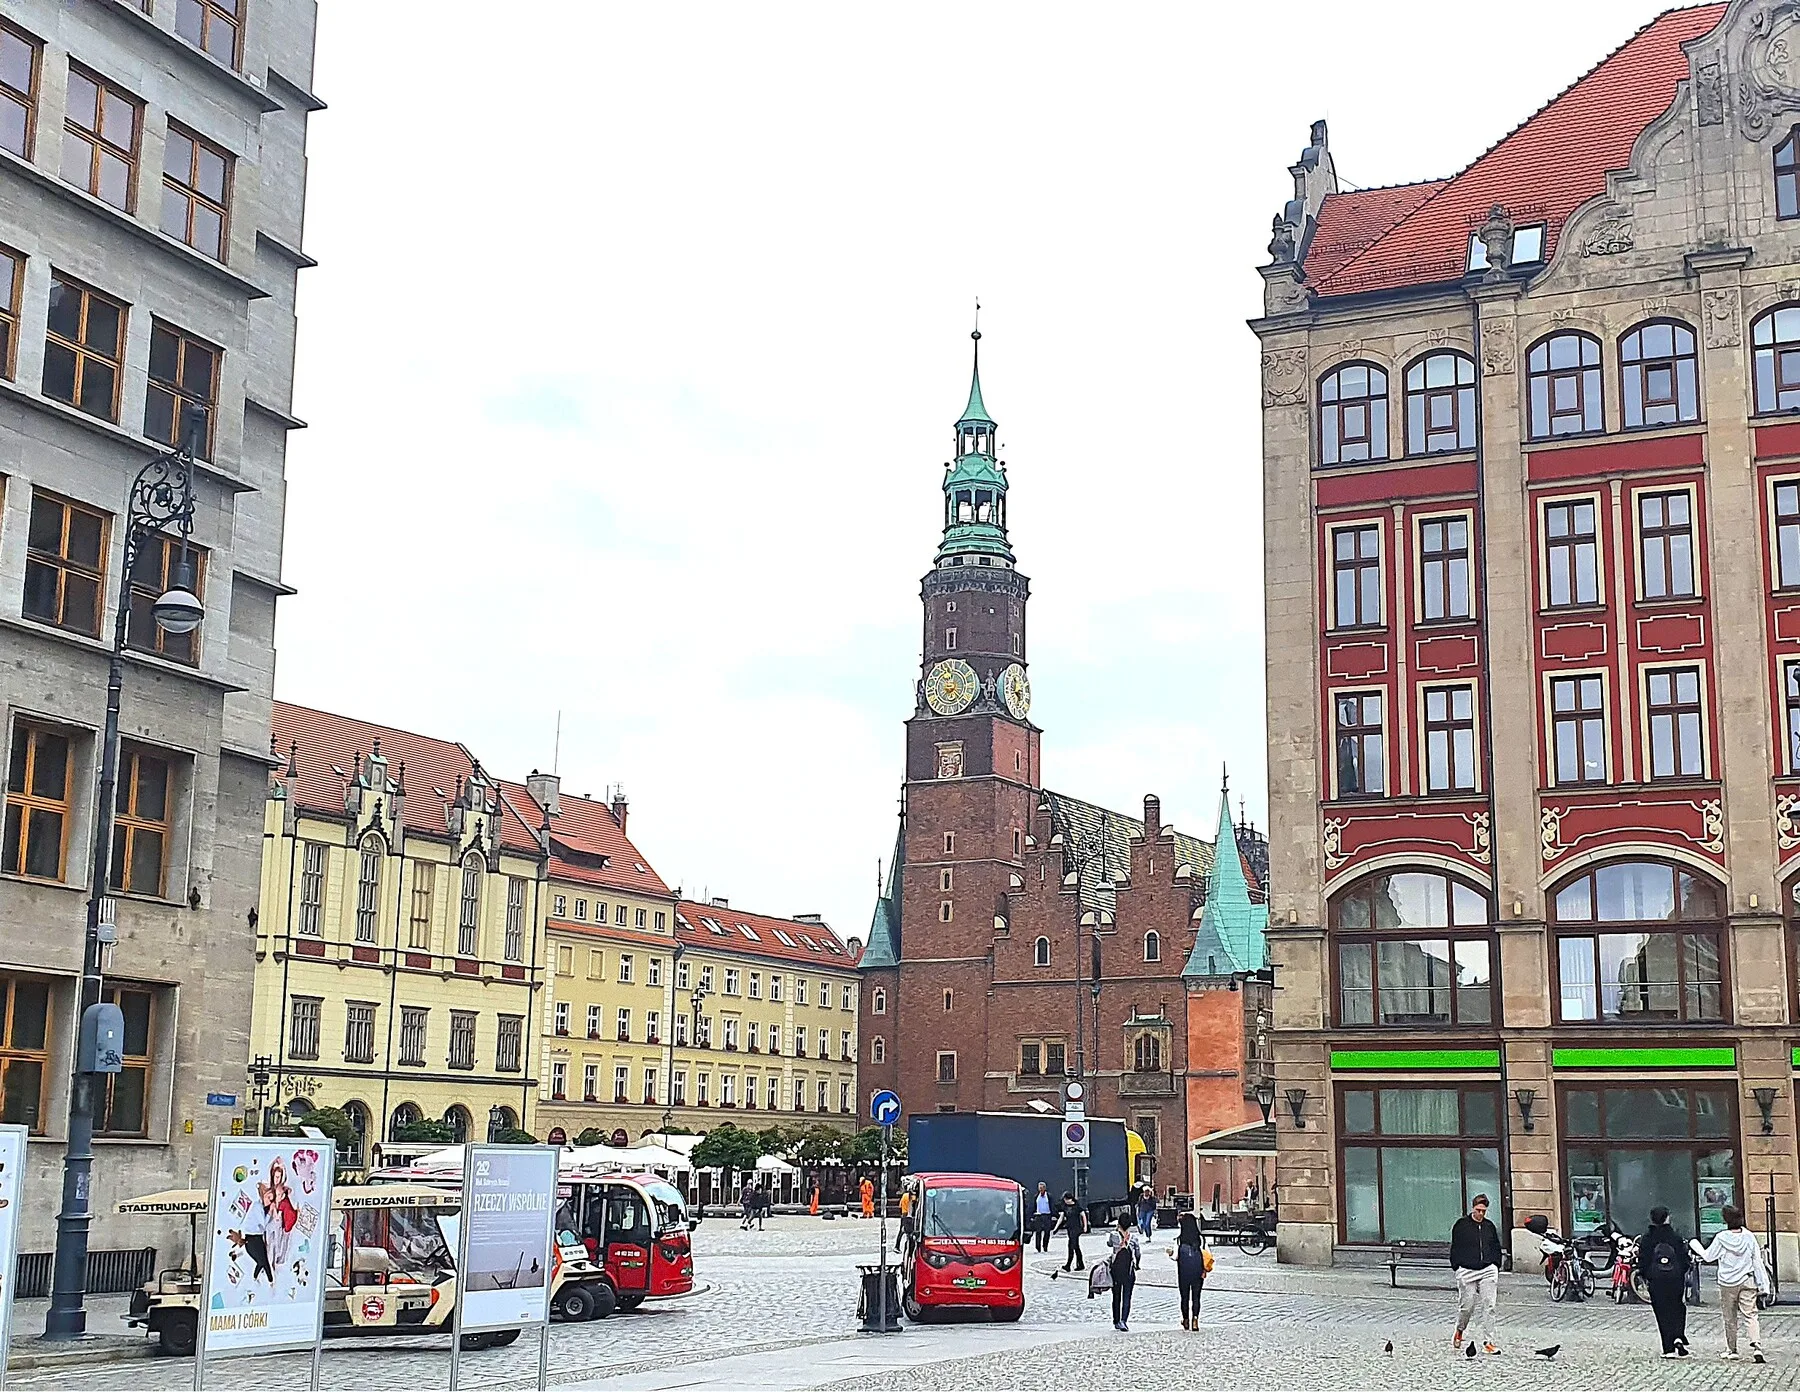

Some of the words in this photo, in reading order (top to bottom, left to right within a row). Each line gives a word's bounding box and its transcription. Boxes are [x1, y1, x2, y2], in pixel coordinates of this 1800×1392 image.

[343, 1196, 416, 1206] ZWIEDZANIE
[474, 1193, 508, 1212] RZECZY
[509, 1189, 548, 1211] WSPÓLNE
[210, 1315, 236, 1331] MAMA
[238, 1314, 242, 1329] I
[243, 1310, 268, 1328] CÓRKI
